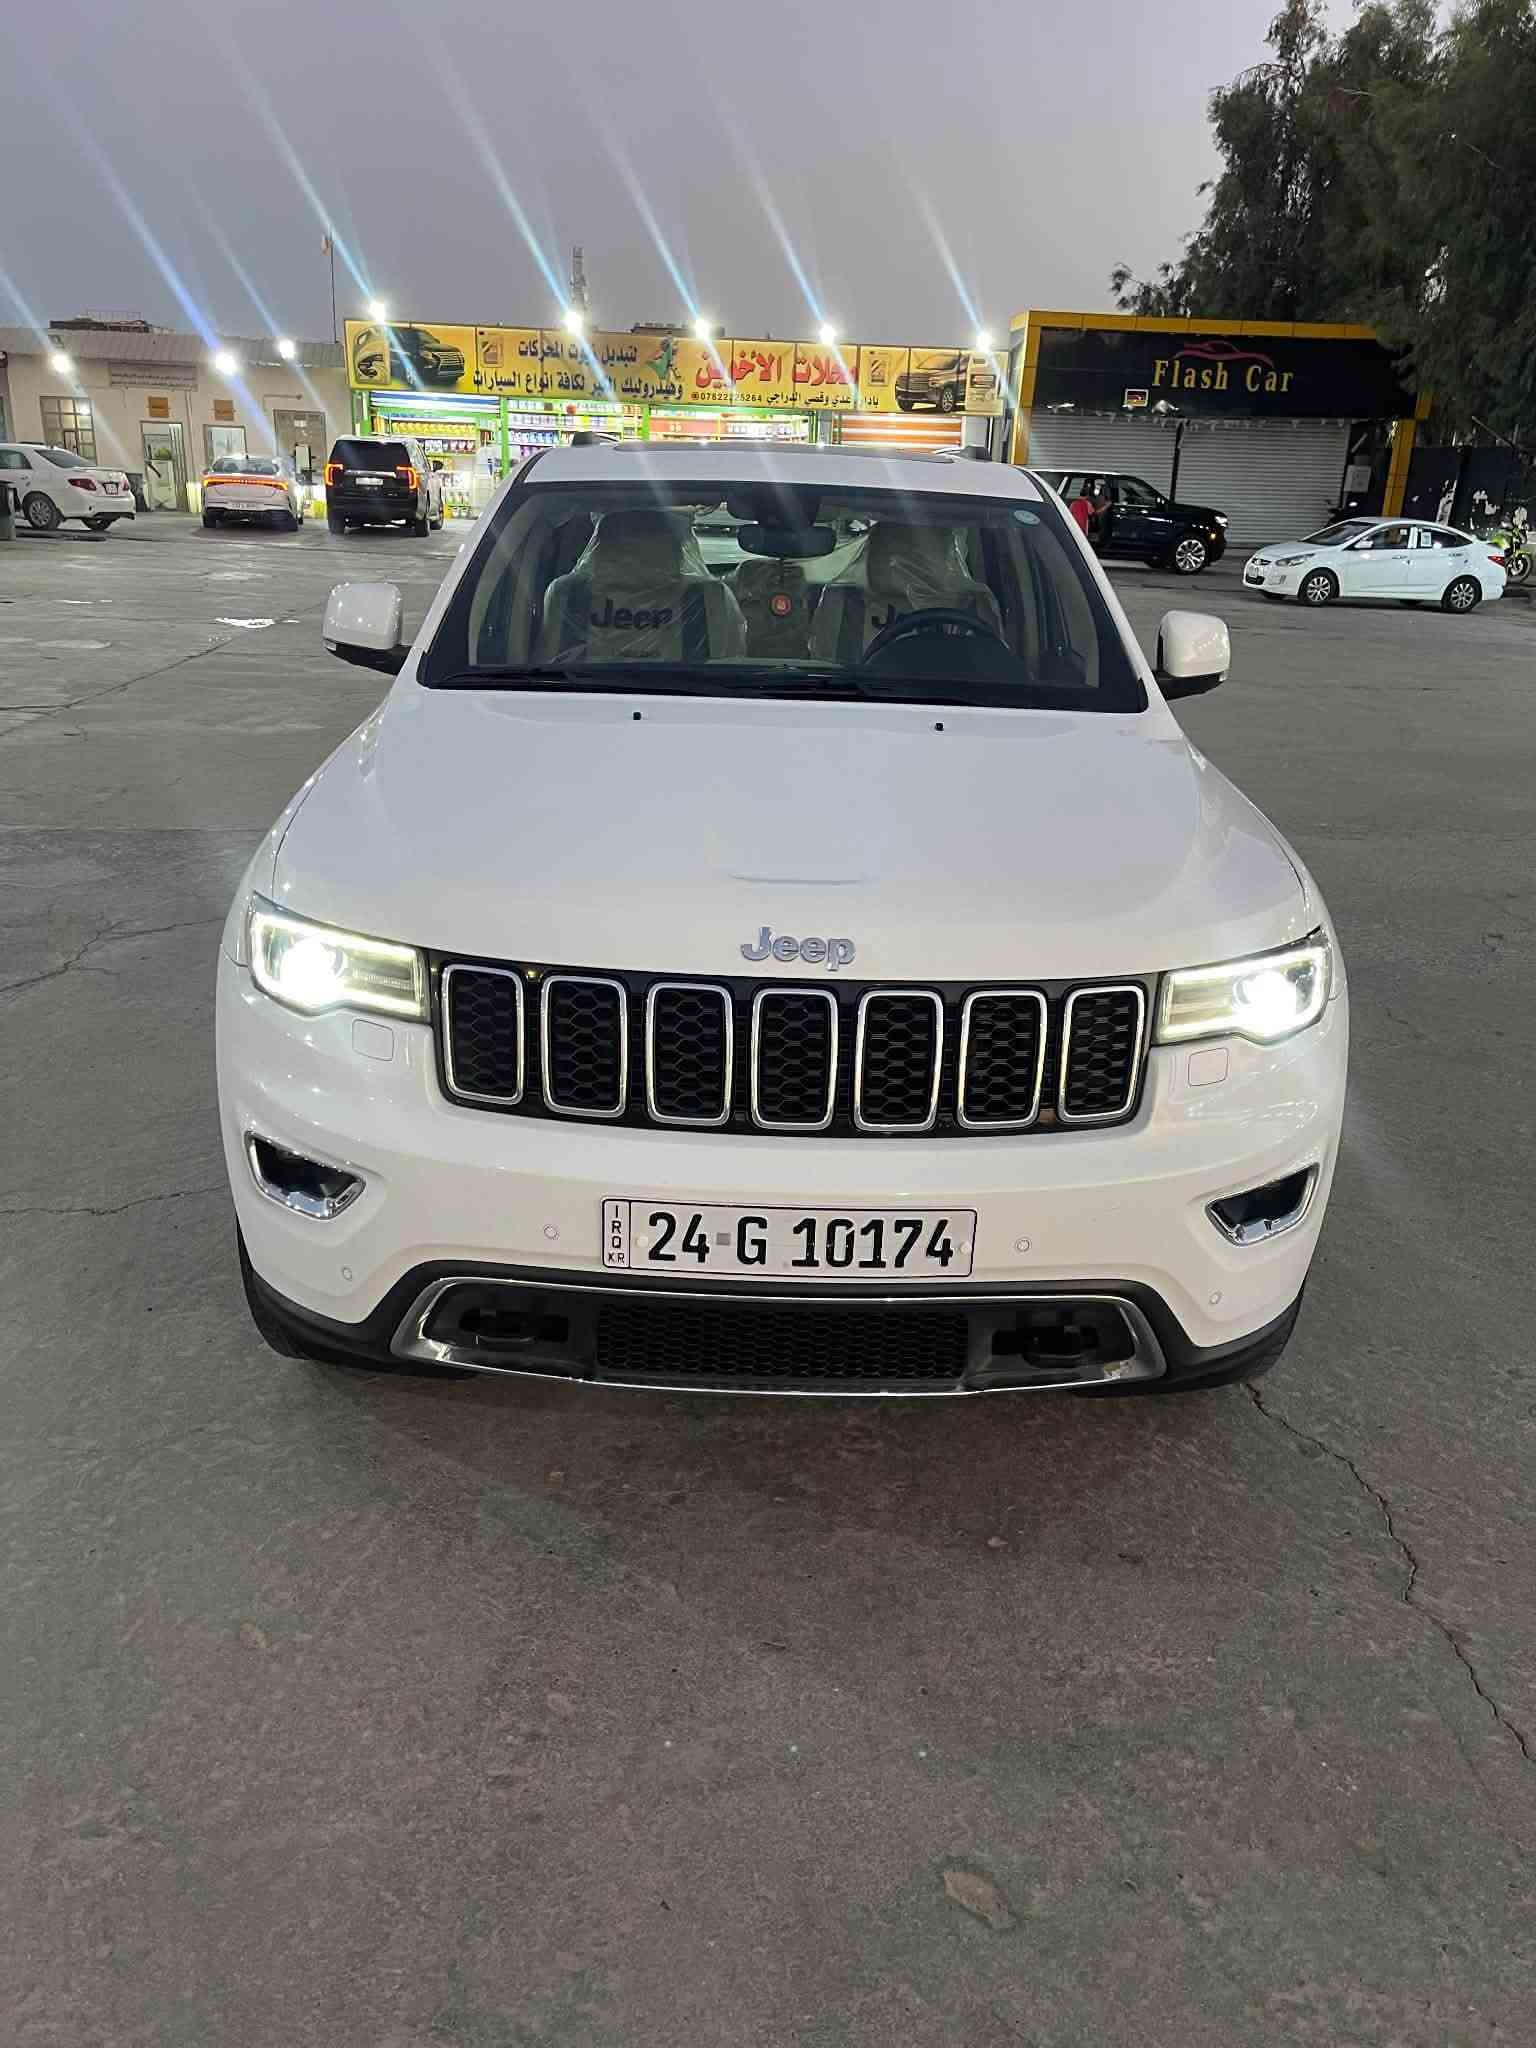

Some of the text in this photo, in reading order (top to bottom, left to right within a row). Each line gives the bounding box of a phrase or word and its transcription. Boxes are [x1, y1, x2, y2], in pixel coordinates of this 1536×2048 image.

[473, 370, 520, 391] السيارات
[558, 370, 585, 391] لكافة
[1152, 359, 1294, 392] Flash Car
[741, 927, 856, 972] Jeep
[648, 1212, 954, 1268] 24 G 10174
[608, 1252, 625, 1264] KR
